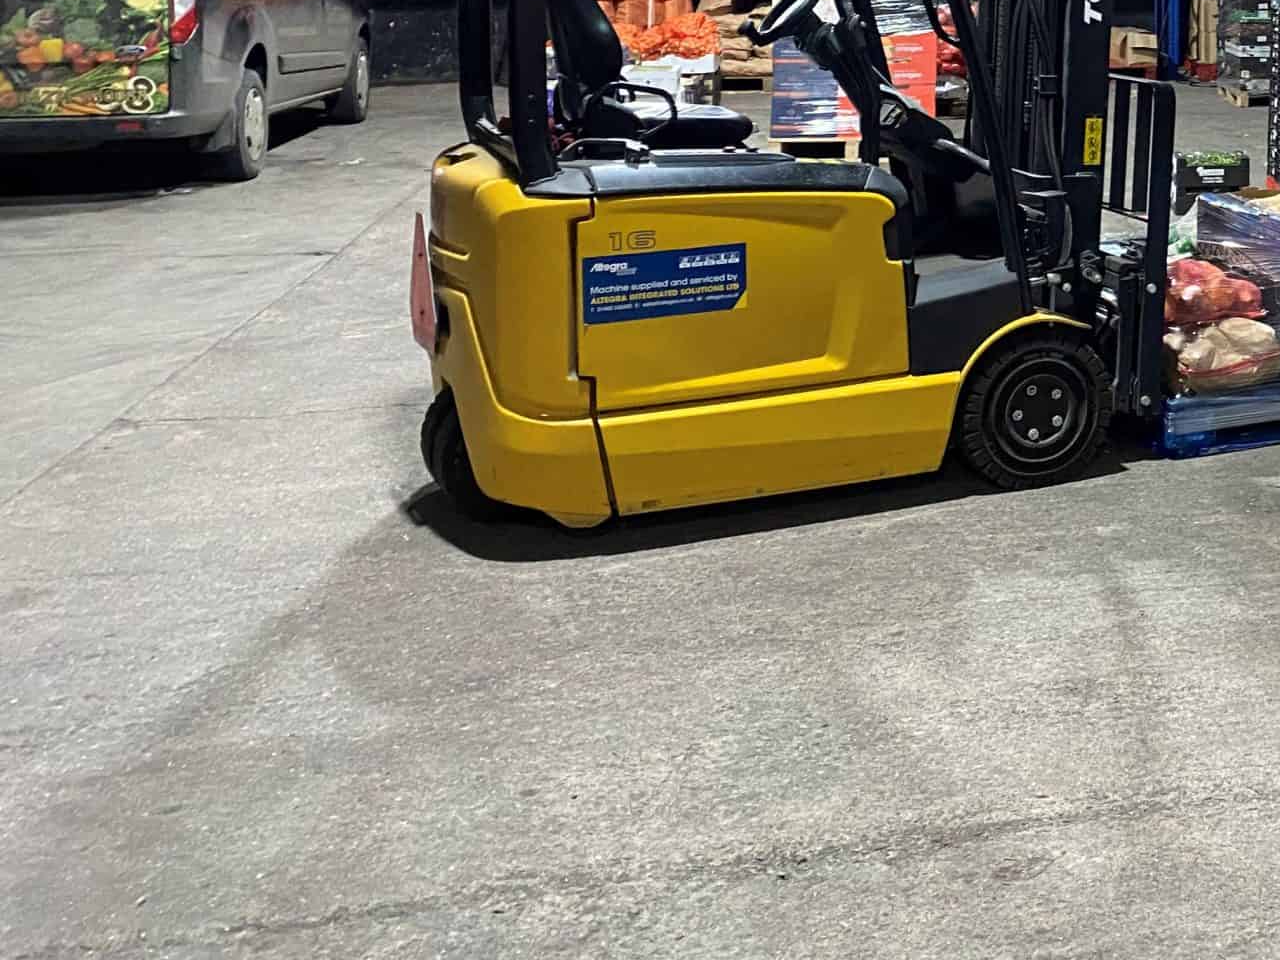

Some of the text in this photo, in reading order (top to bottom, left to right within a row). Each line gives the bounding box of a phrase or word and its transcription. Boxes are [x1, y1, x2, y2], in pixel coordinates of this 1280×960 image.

[590, 272, 738, 296] Machine supplied and serviced by
[629, 289, 679, 302] INTEGRATED
[680, 284, 725, 296] SOLUTIONS
